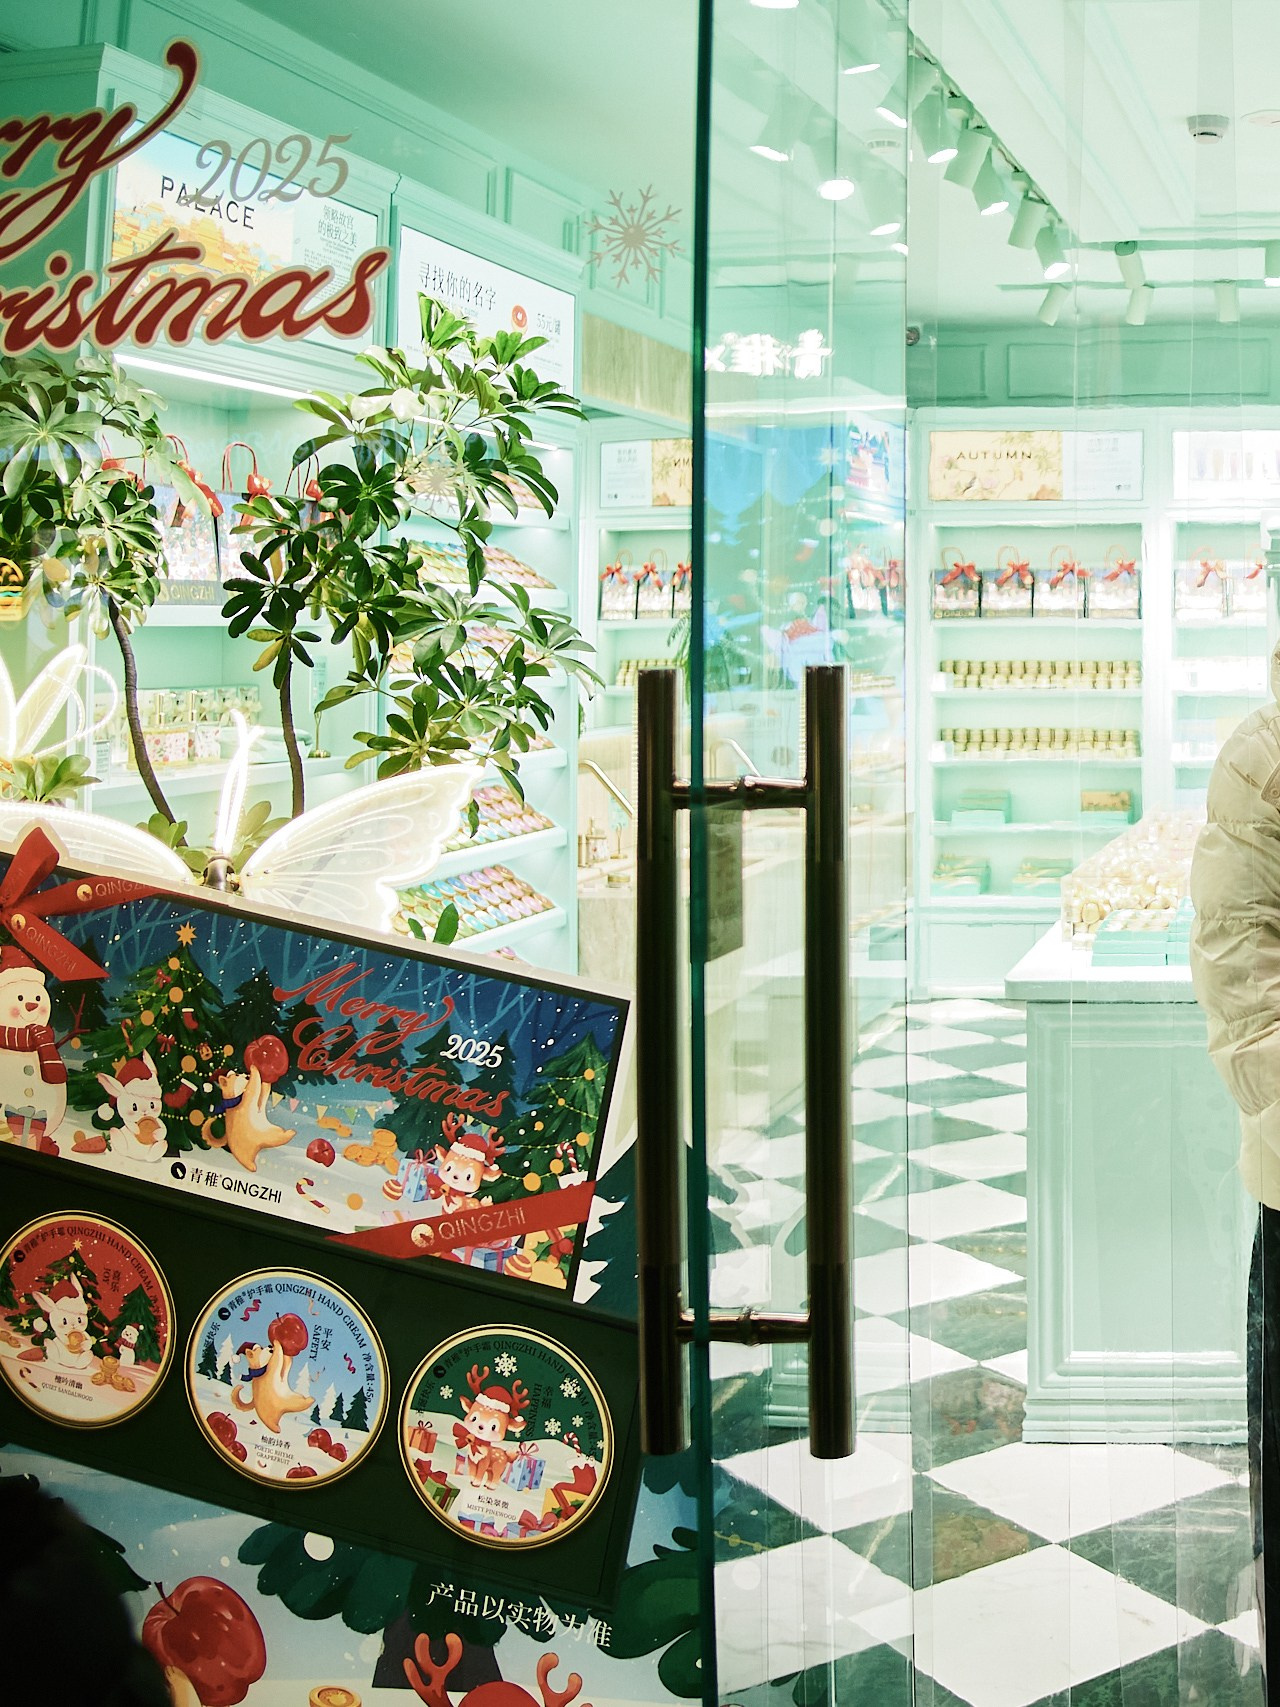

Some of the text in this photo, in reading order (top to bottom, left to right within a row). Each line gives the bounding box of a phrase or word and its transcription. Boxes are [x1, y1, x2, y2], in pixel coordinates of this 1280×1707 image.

[179, 133, 353, 208] 2025
[160, 175, 256, 230] PALACE
[419, 261, 497, 311] 寻找你的名字
[956, 451, 1033, 460] AUTUMN
[272, 962, 456, 1055] Merry
[292, 1016, 510, 1118] Christmas
[440, 1034, 505, 1069] 2025
[221, 1176, 282, 1203] QINGZHI
[438, 1207, 527, 1240] QINGZHI
[67, 1226, 106, 1243] QINGZHI
[106, 1237, 132, 1260] HAND
[130, 1256, 154, 1291] CREAM
[275, 1283, 318, 1300] QINGZHI
[317, 1293, 344, 1316] HAND
[341, 1314, 368, 1349] CREAM
[308, 1324, 323, 1361] SAFETY
[321, 1326, 333, 1351] 平安
[492, 1340, 537, 1357] QINGZHI
[536, 1352, 565, 1375] HAND
[524, 1383, 543, 1438] HAPPINESS
[254, 1444, 294, 1460] POETIC RHYME
[256, 1451, 291, 1465] GRAPEFRUIT
[466, 1503, 517, 1521] MISTY PINEWOOD
[425, 1582, 613, 1648] 产品以实物为准
